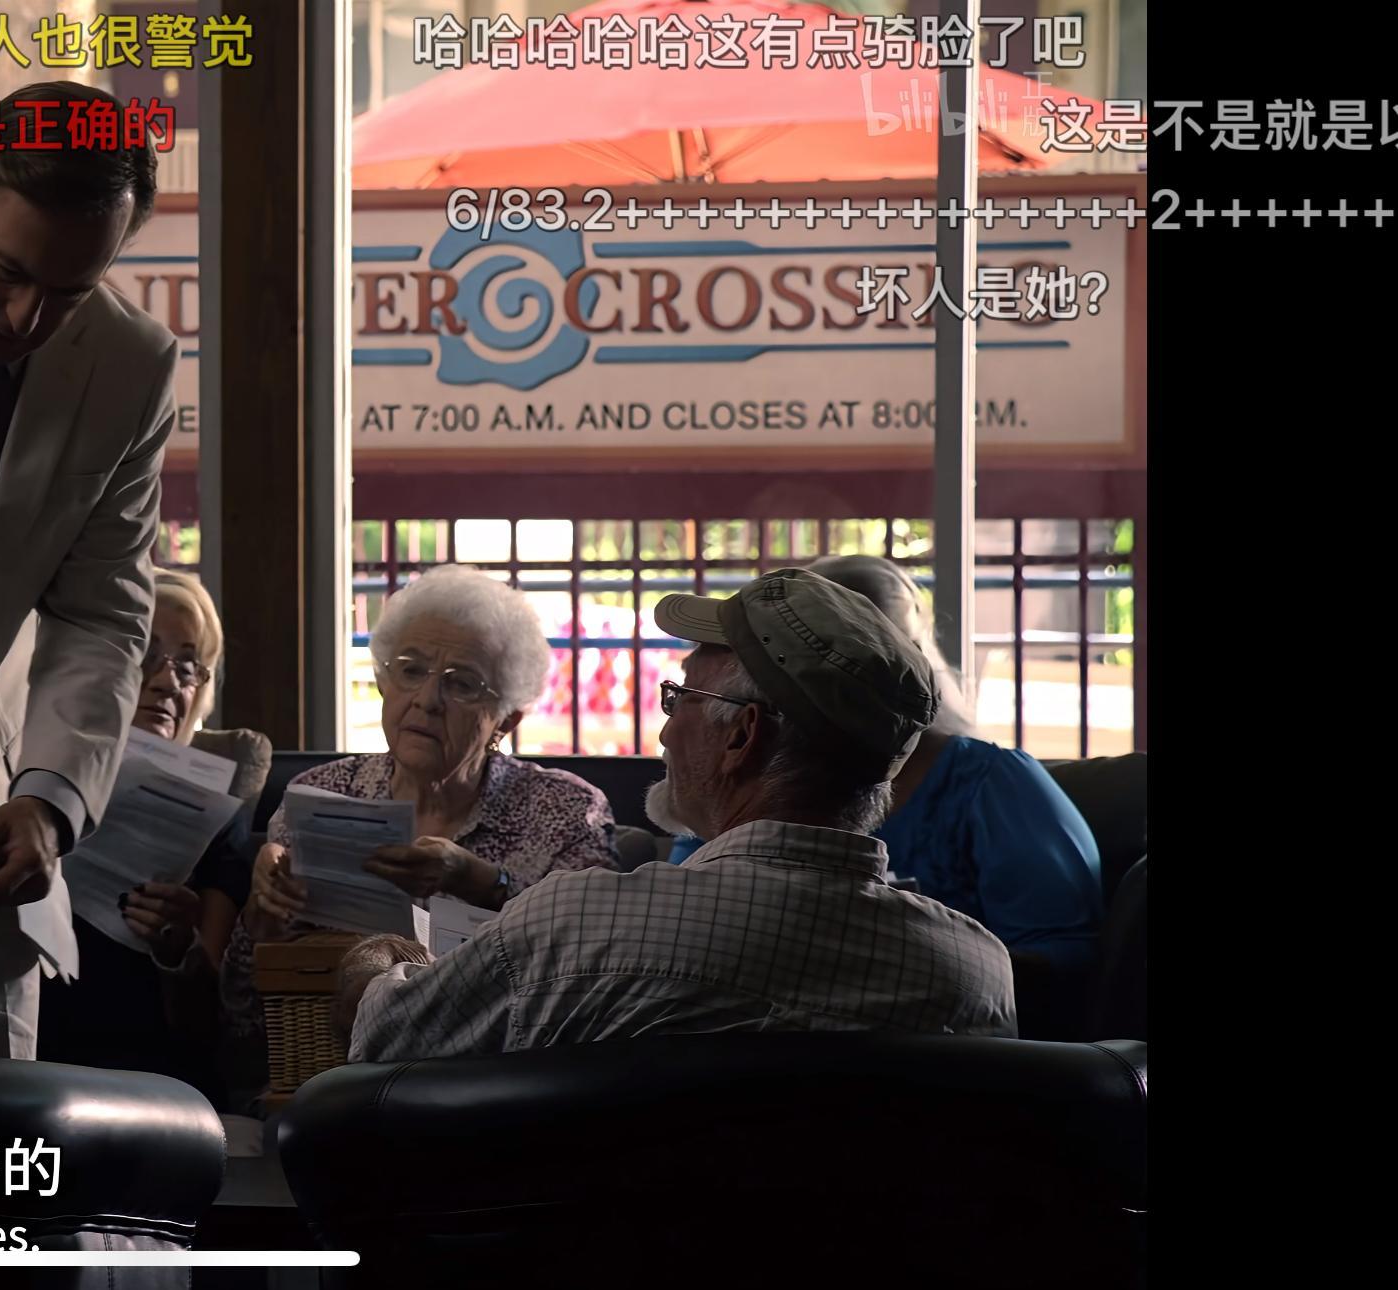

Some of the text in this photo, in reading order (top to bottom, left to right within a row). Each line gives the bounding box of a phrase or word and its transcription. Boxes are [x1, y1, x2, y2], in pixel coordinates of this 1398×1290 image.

[360, 404, 401, 432] AT
[411, 403, 480, 432] 7:00
[490, 403, 565, 431] A.M.
[576, 402, 652, 431] AND
[662, 400, 807, 431] CLOSES
[818, 401, 861, 429] AT
